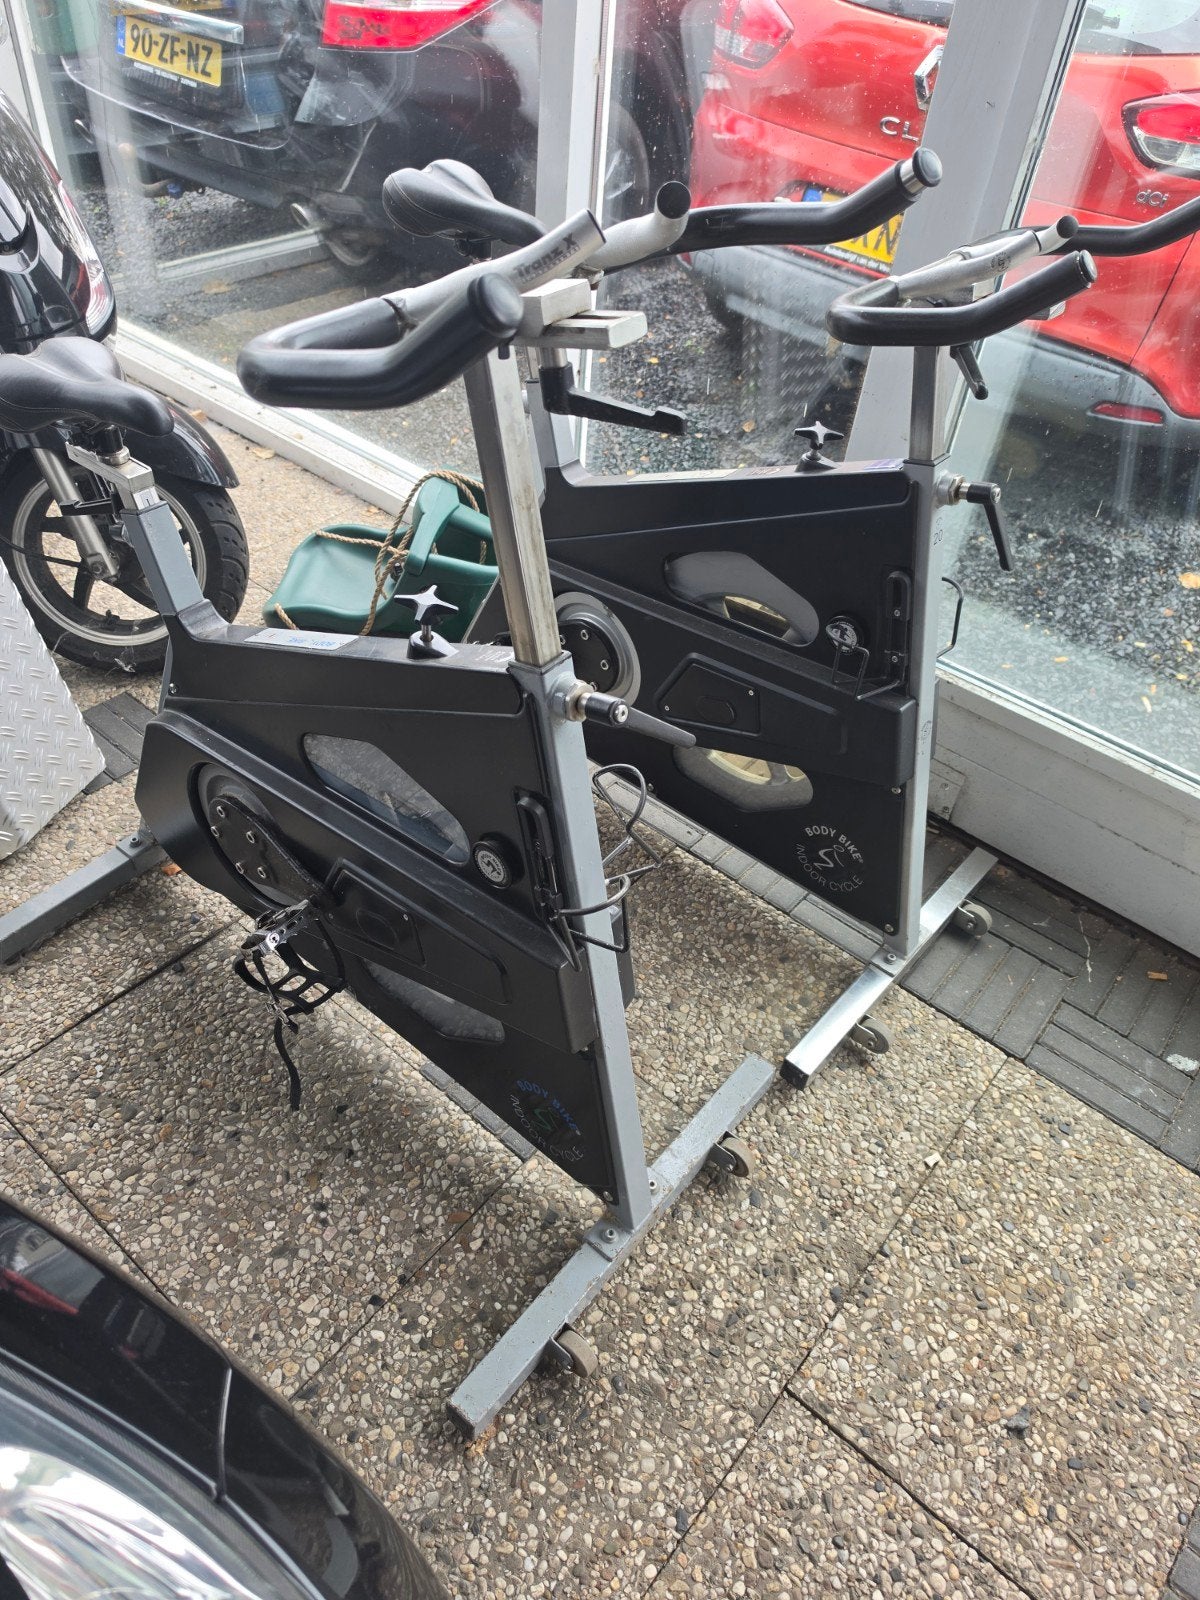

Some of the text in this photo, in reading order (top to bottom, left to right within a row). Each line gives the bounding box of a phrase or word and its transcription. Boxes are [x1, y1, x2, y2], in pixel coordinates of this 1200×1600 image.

[131, 23, 213, 77] 90-ZF-NZ
[880, 116, 919, 142] CL
[513, 246, 563, 277] Tranz
[562, 233, 578, 250] X
[805, 825, 837, 837] BODY
[796, 843, 864, 892] INDOOR CYCLE
[517, 1080, 548, 1098] BODY
[510, 1094, 584, 1162] INDOOR CYCLE
